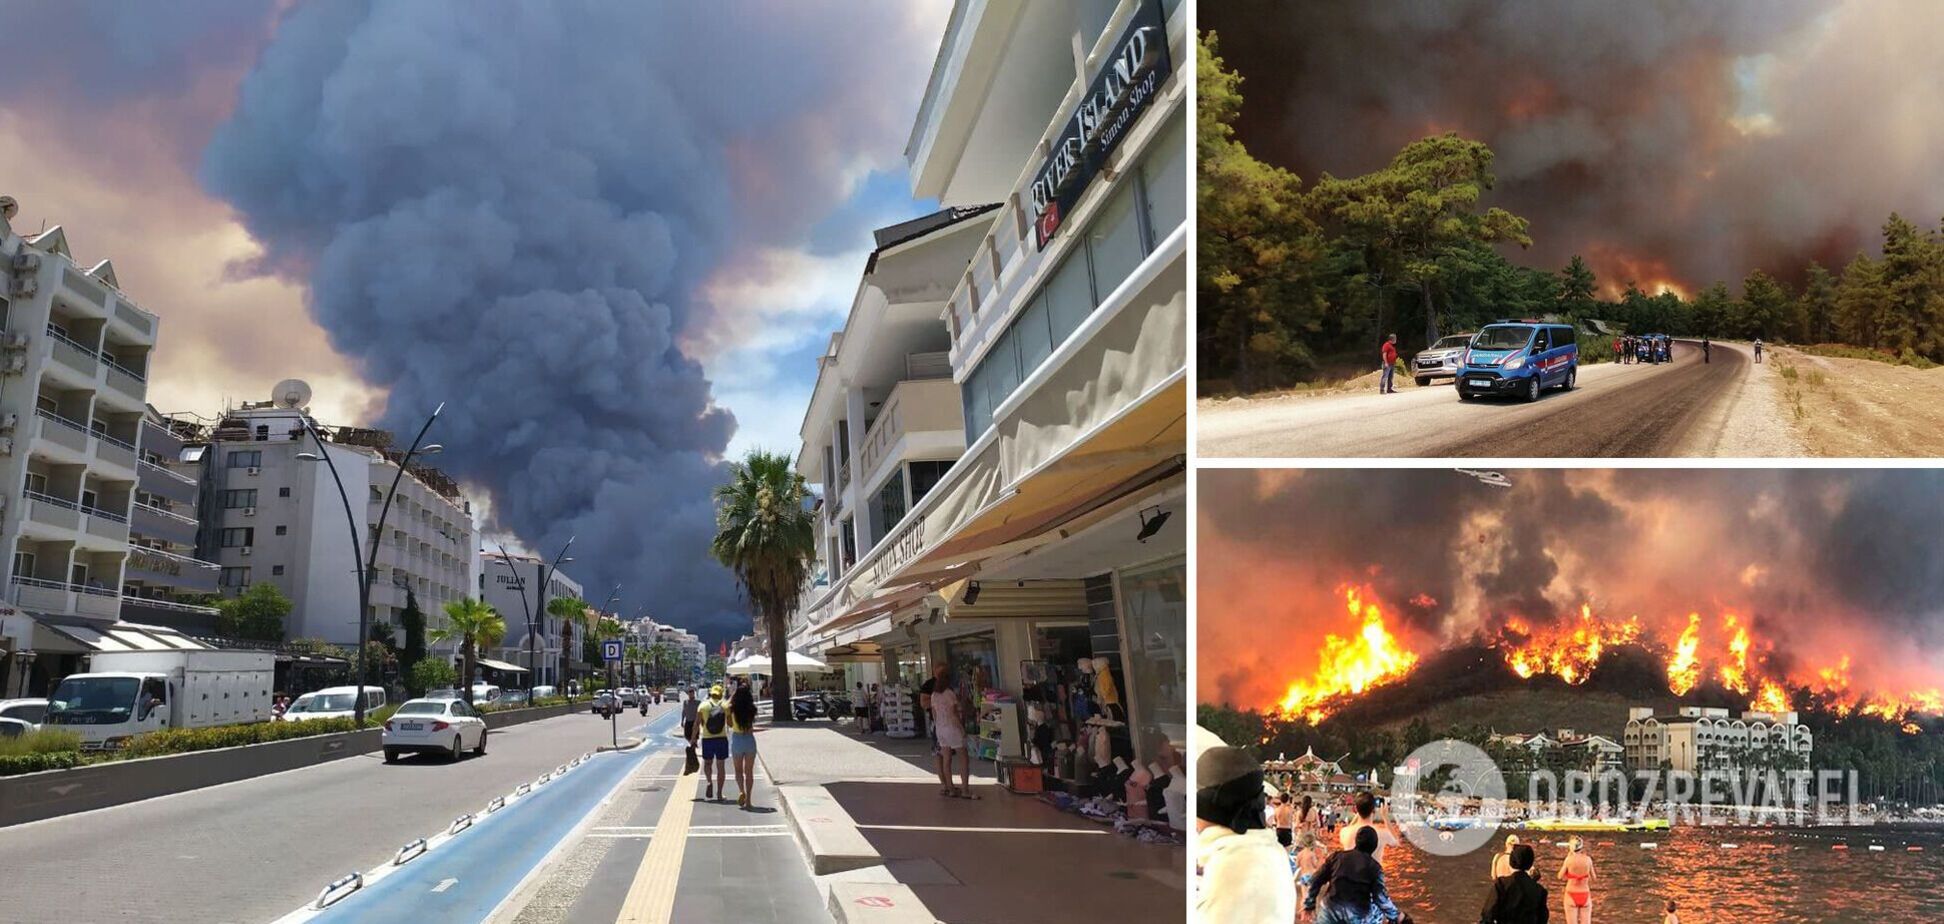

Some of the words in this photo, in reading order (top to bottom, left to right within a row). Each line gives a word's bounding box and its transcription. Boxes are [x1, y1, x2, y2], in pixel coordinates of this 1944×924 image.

[1031, 138, 1077, 218] RIVER
[1076, 27, 1148, 150] ISLAND
[1100, 107, 1129, 151] Simon
[1129, 70, 1156, 112] Shop
[900, 515, 925, 564] SHOP
[496, 575, 526, 585] JULIAN
